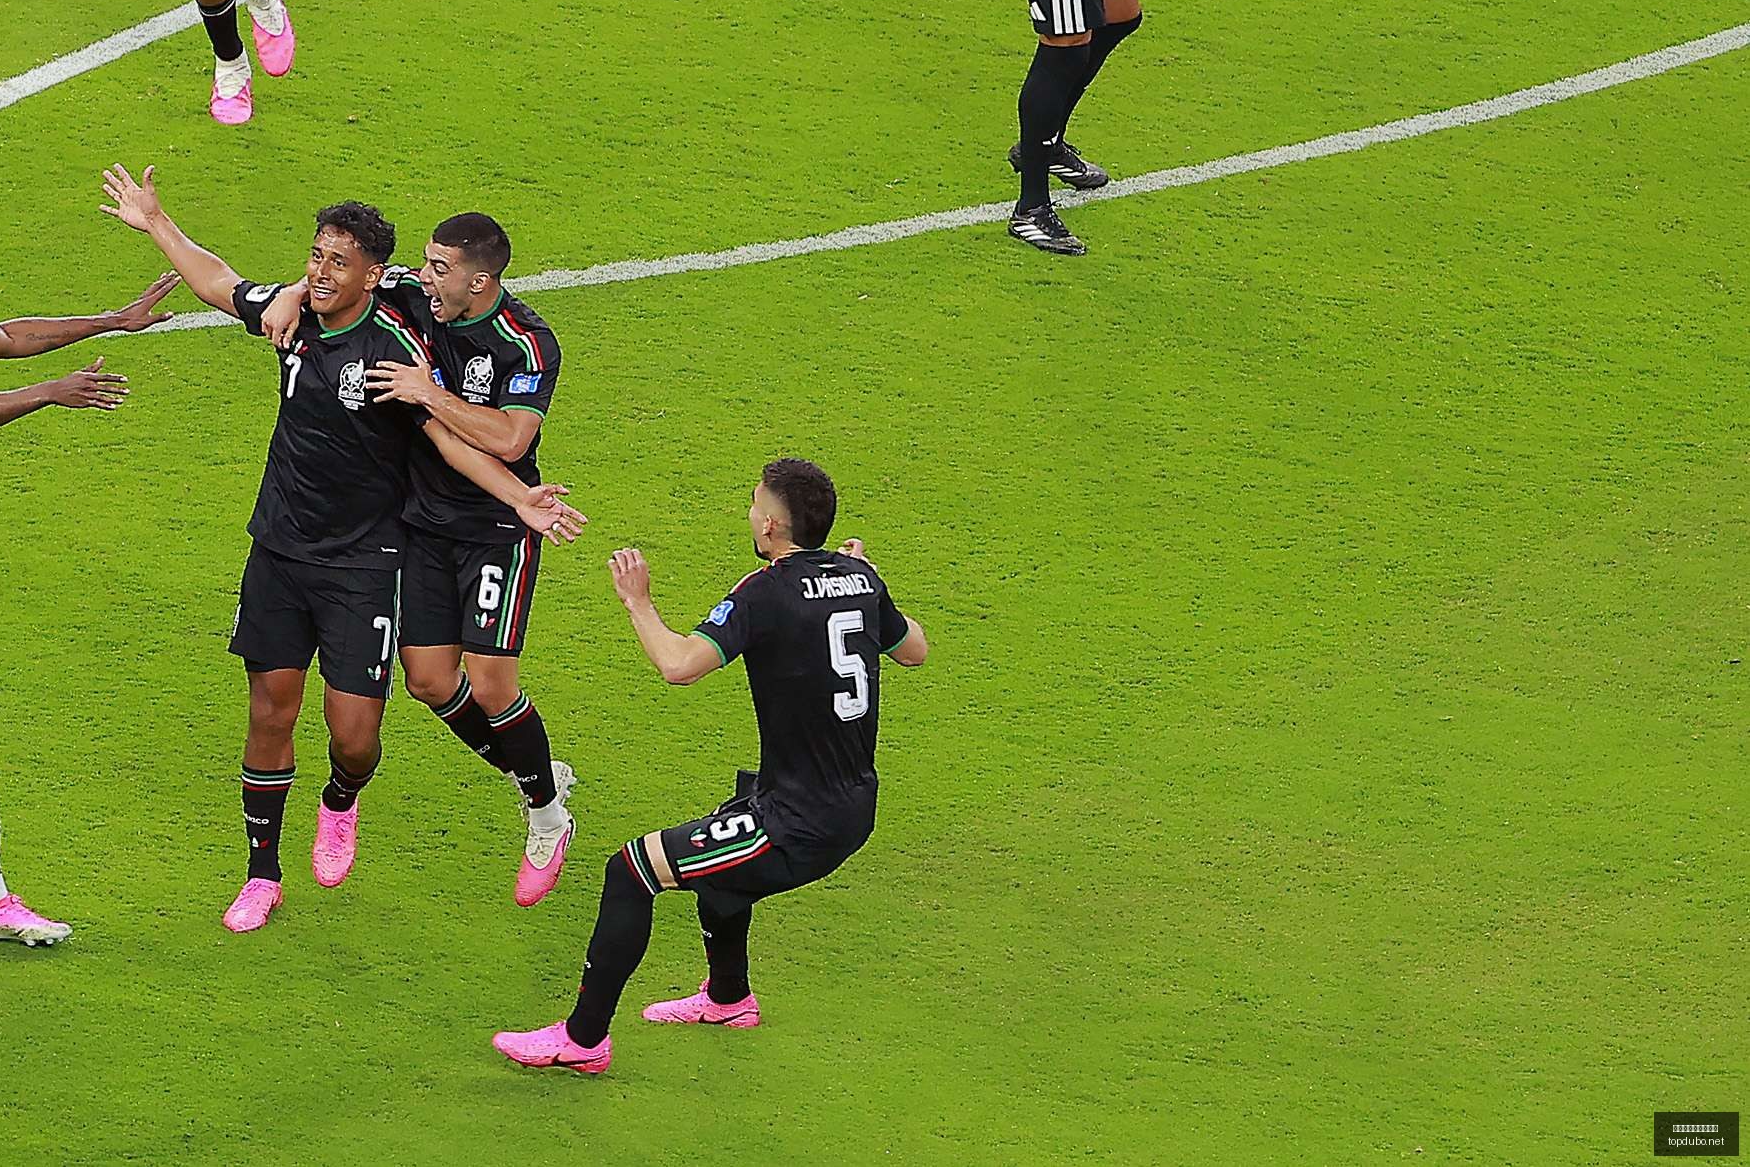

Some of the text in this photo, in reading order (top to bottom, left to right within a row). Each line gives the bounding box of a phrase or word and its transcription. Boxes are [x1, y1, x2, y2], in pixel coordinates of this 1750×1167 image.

[286, 354, 303, 399] 7
[477, 564, 503, 611] 6
[373, 616, 392, 662] 7
[827, 610, 869, 722] 5
[709, 813, 755, 842] 5
